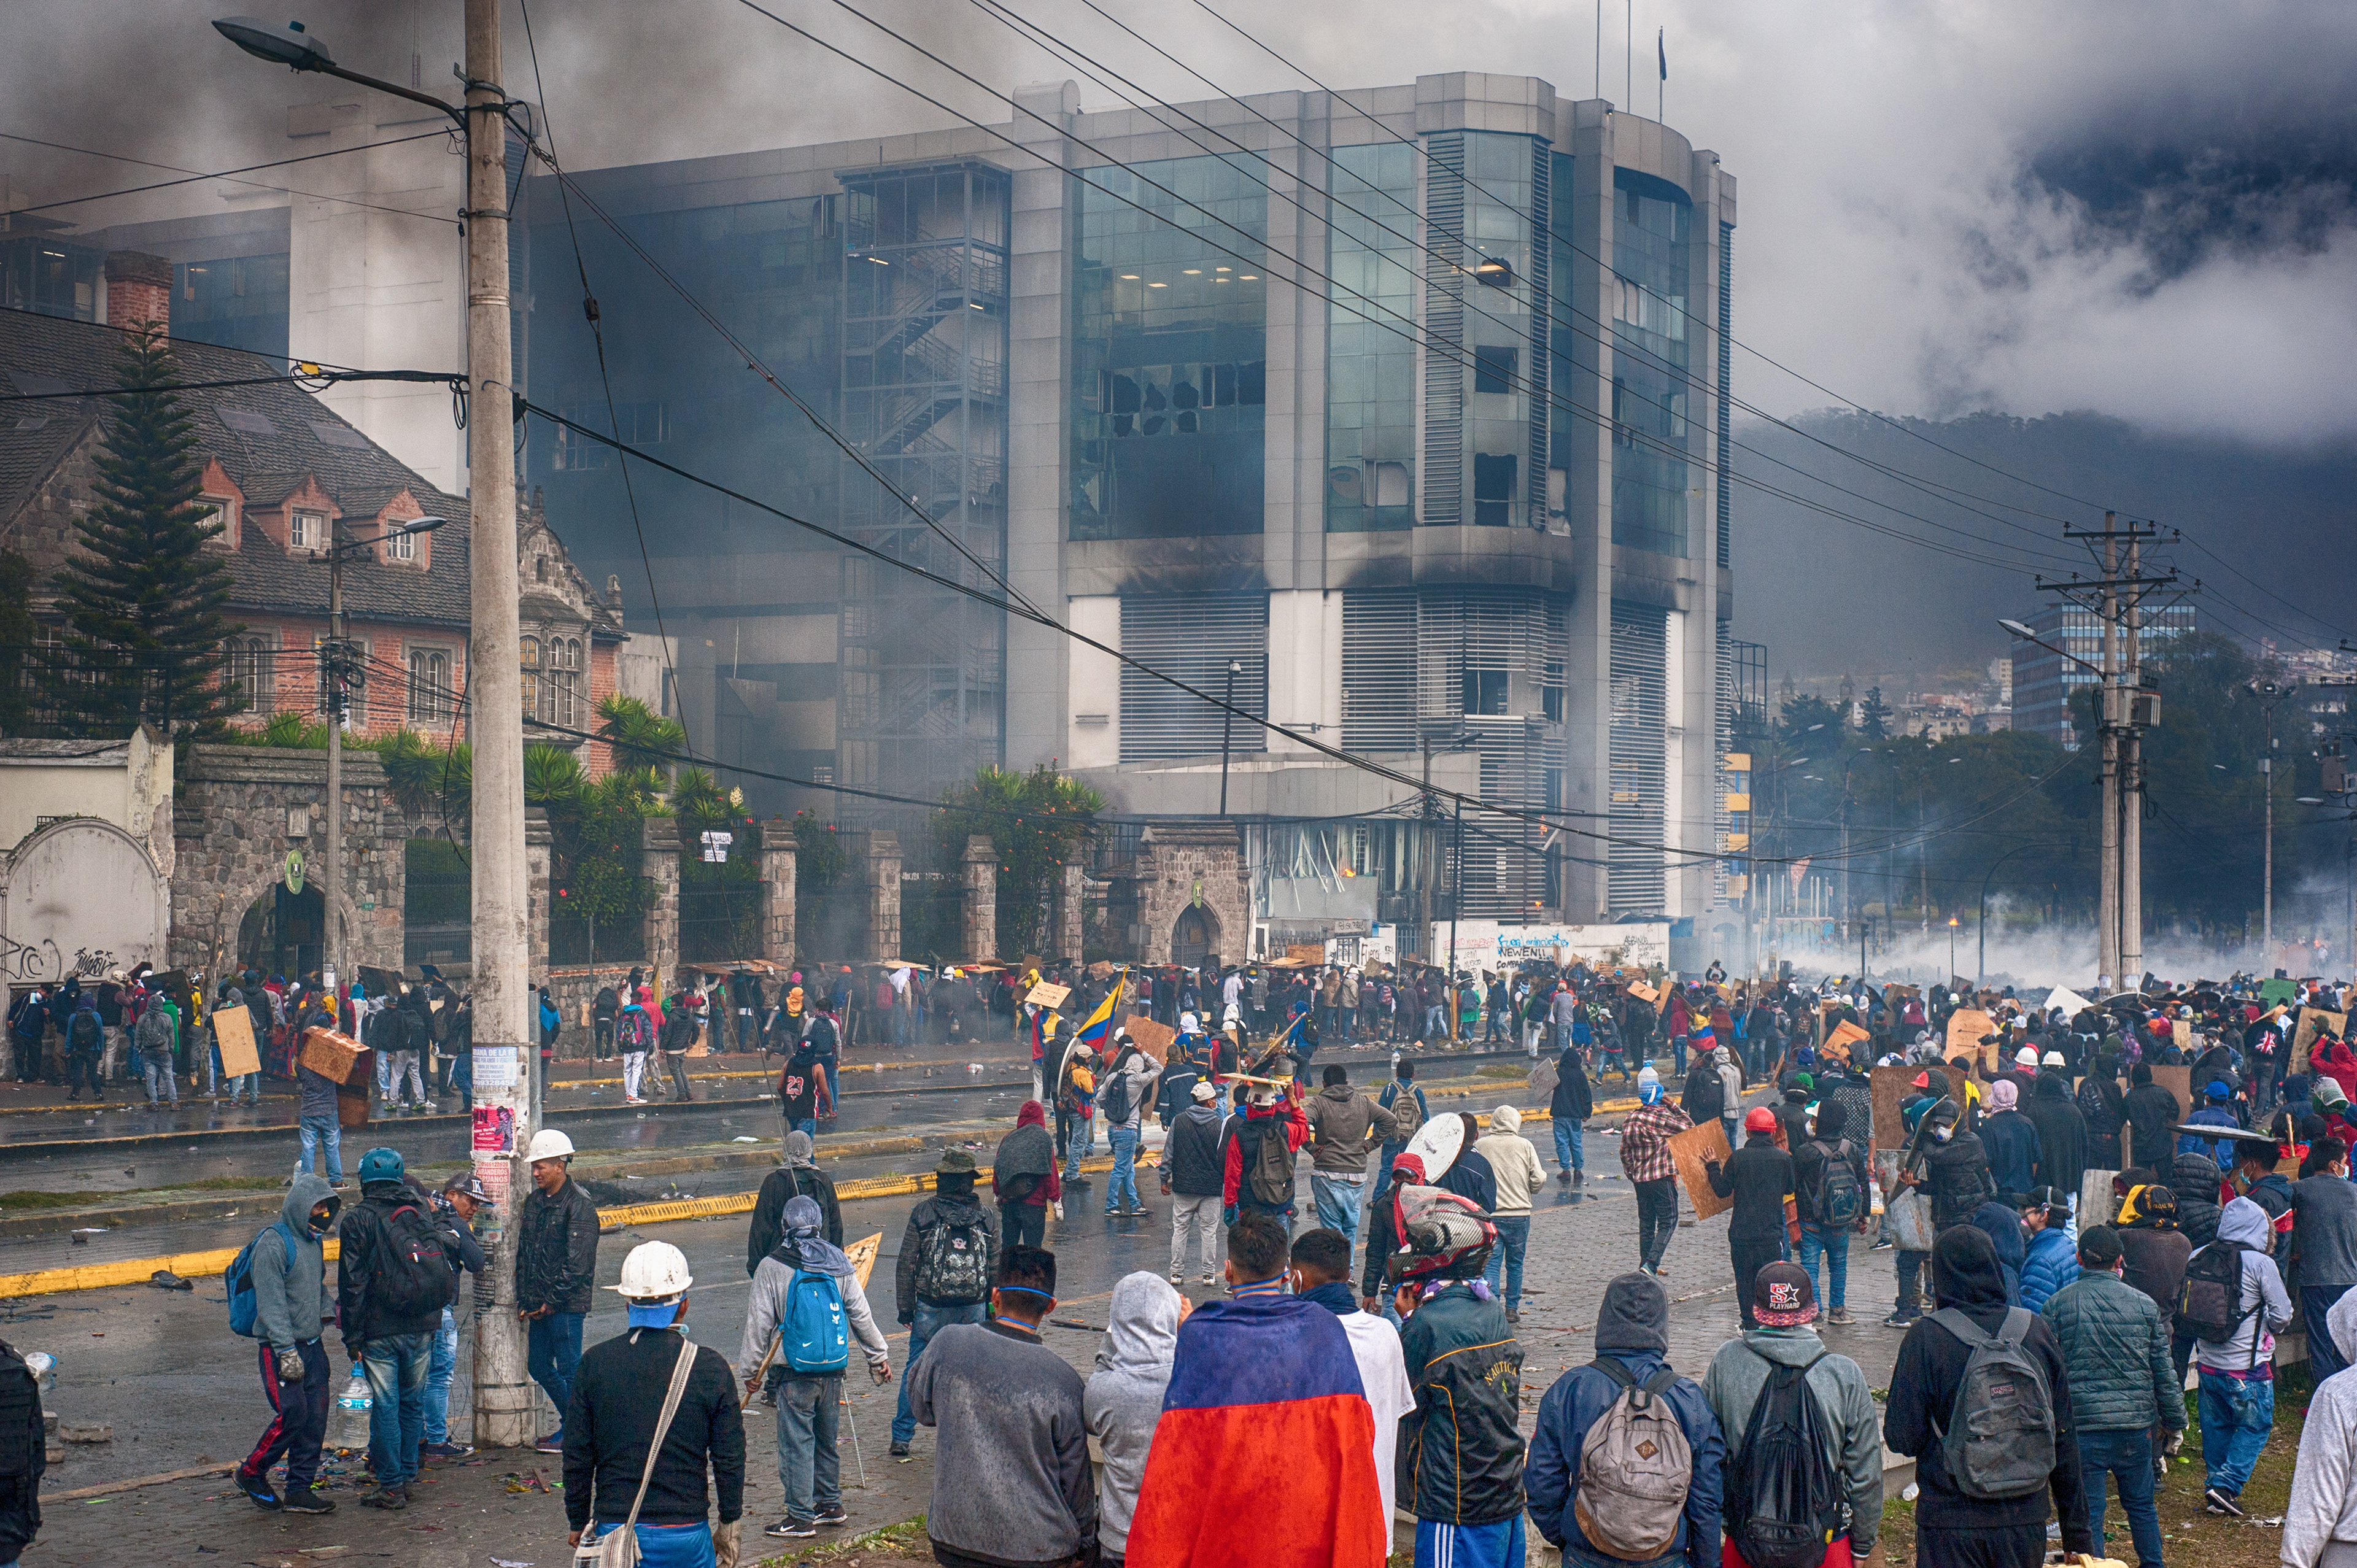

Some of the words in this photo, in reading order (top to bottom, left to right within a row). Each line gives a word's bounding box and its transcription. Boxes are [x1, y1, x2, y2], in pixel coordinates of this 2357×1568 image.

[786, 1076, 804, 1095] 23
[1770, 1302, 1800, 1310] PLAYHARD
[829, 1302, 845, 1345] NKE
[1484, 1361, 1517, 1387] NAUTICA
